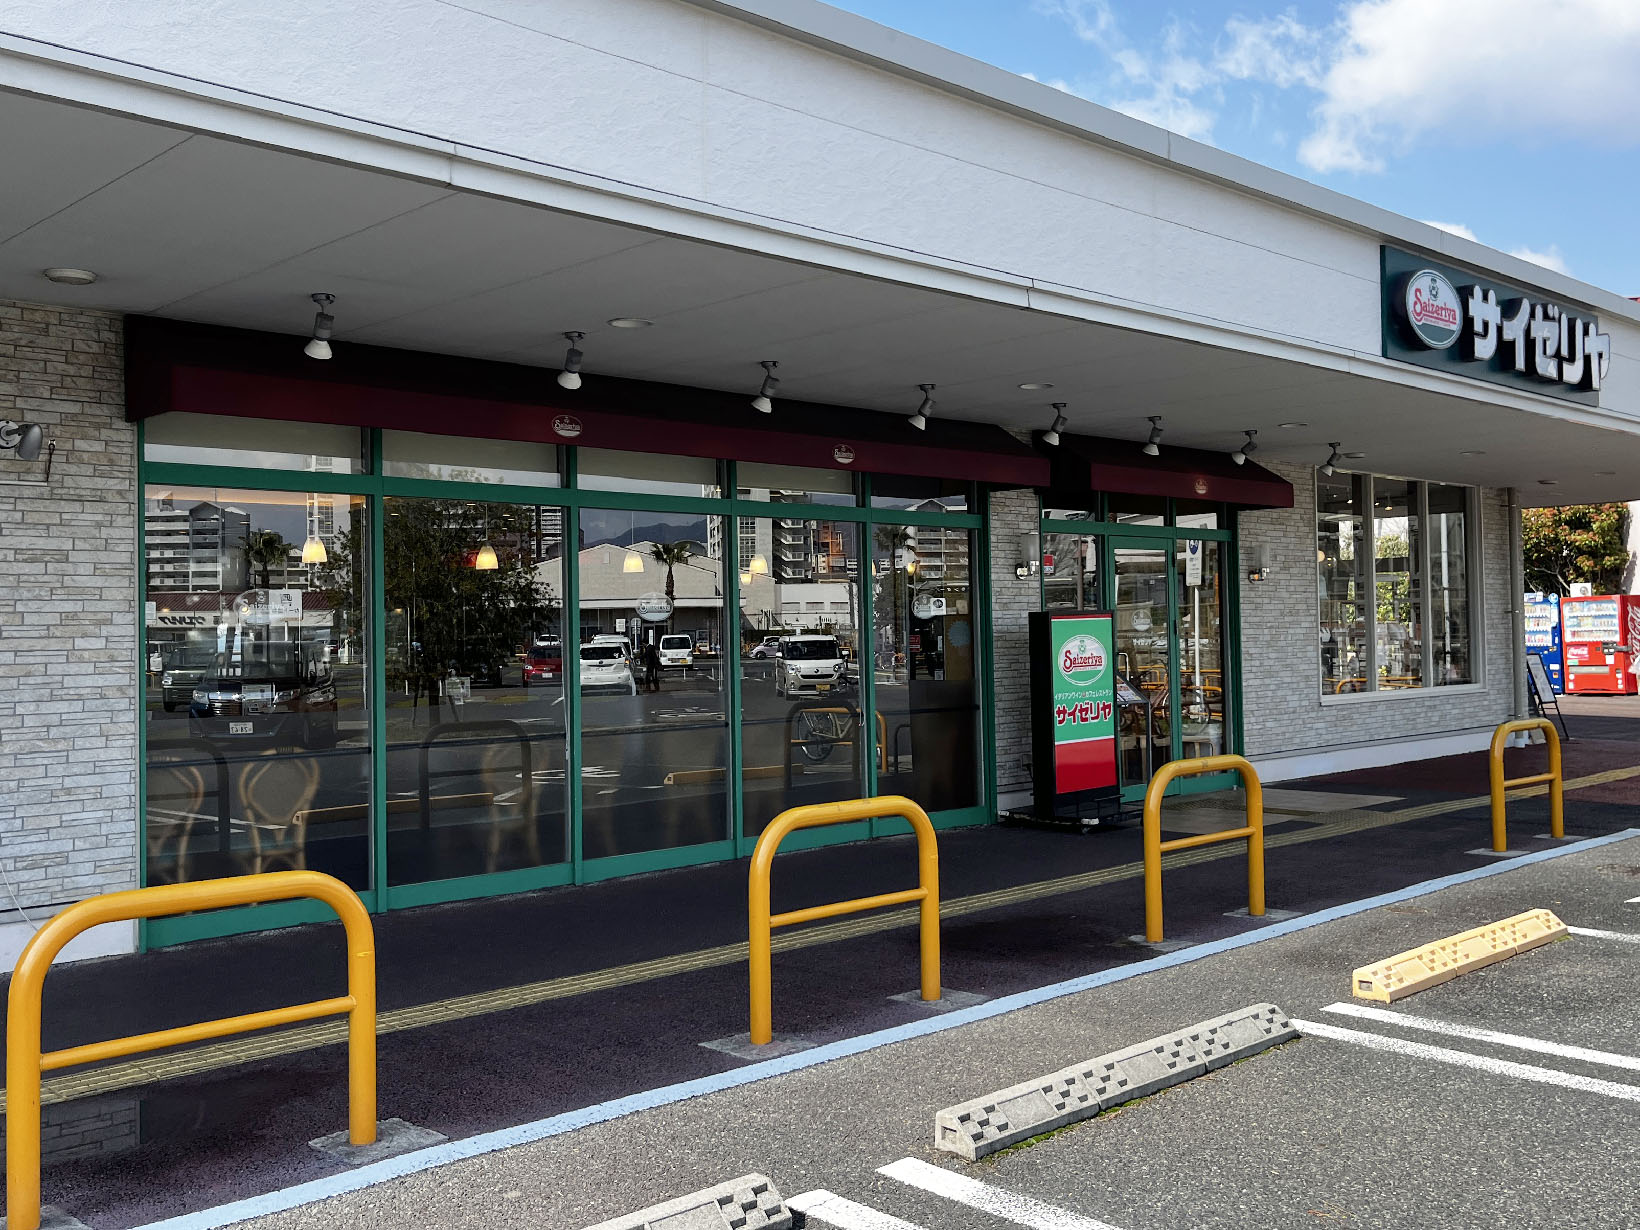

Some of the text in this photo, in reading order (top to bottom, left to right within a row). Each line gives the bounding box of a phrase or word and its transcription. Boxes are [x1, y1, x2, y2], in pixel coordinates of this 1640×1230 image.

[1411, 287, 1457, 325] Saizeriya
[1468, 285, 1611, 391] サイゼリヤ
[1062, 650, 1103, 672] Saizeriya
[1055, 700, 1113, 727] サイゼリヤ
